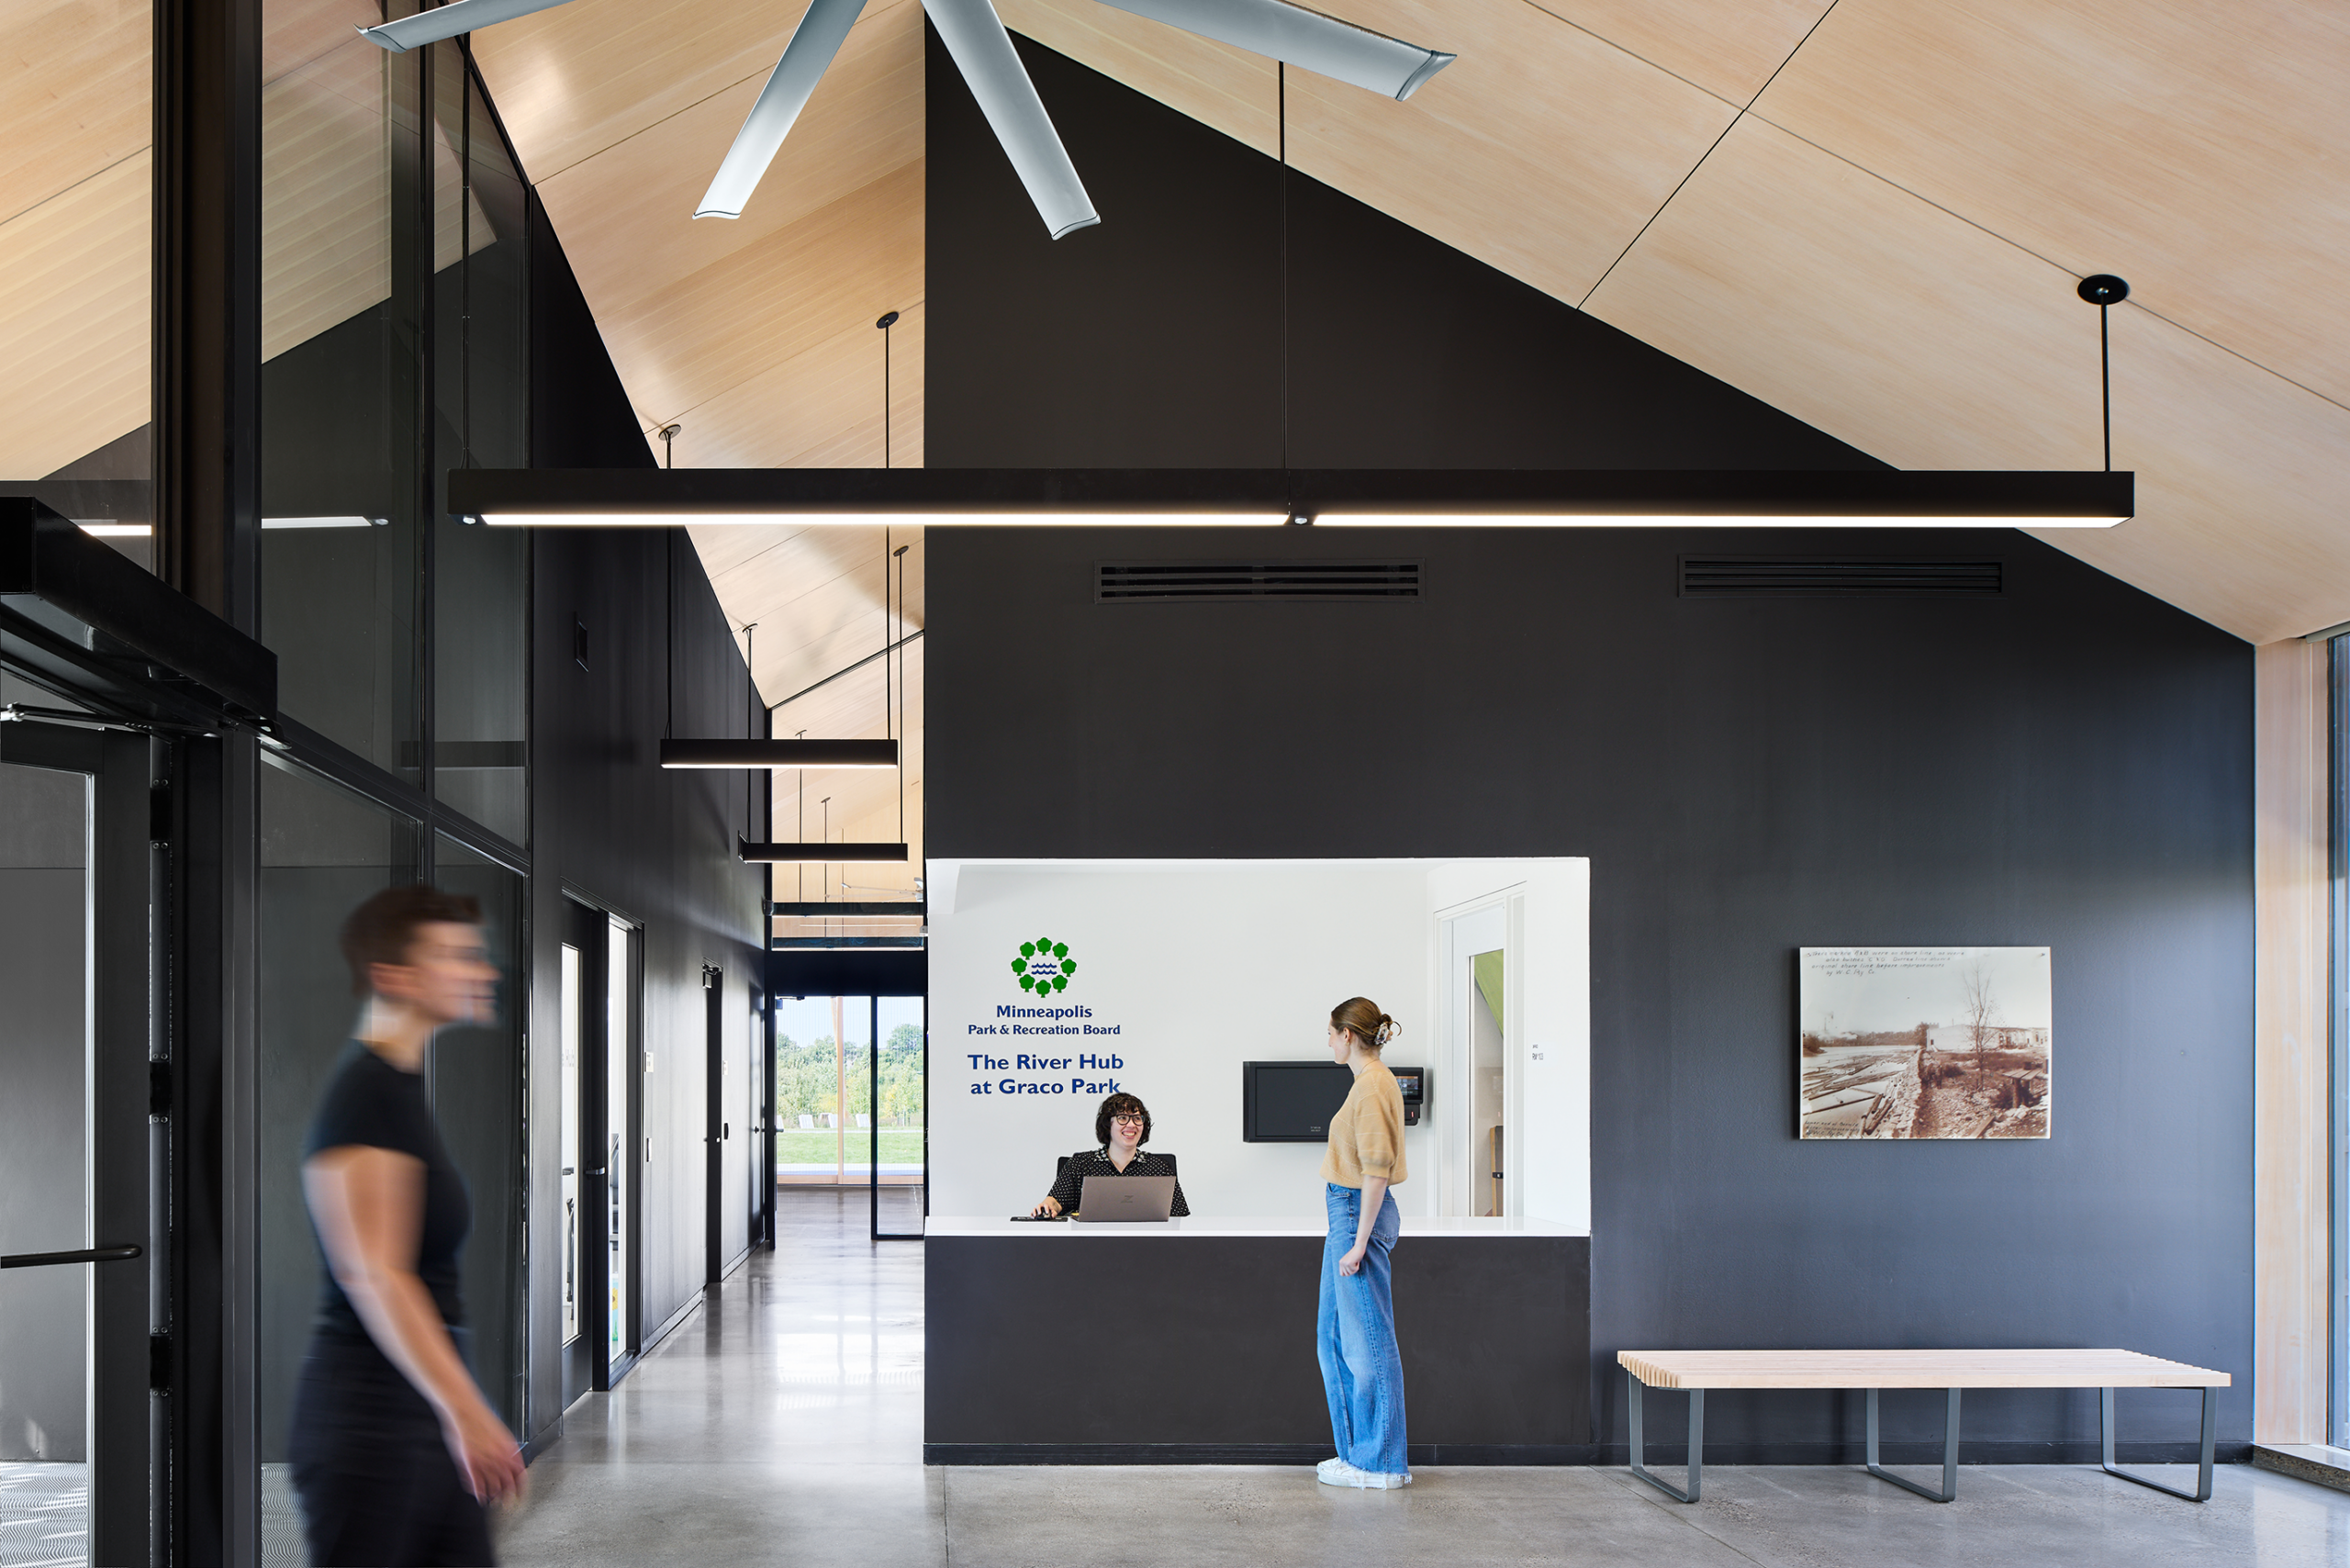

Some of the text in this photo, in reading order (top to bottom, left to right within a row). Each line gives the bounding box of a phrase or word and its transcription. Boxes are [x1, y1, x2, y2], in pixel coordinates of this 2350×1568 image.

[996, 1004, 1093, 1021] Minneapolis
[968, 1024, 1121, 1035] Park & Recreation Board
[967, 1053, 1124, 1070] The River Hub
[970, 1078, 1121, 1095] at Graco Park
